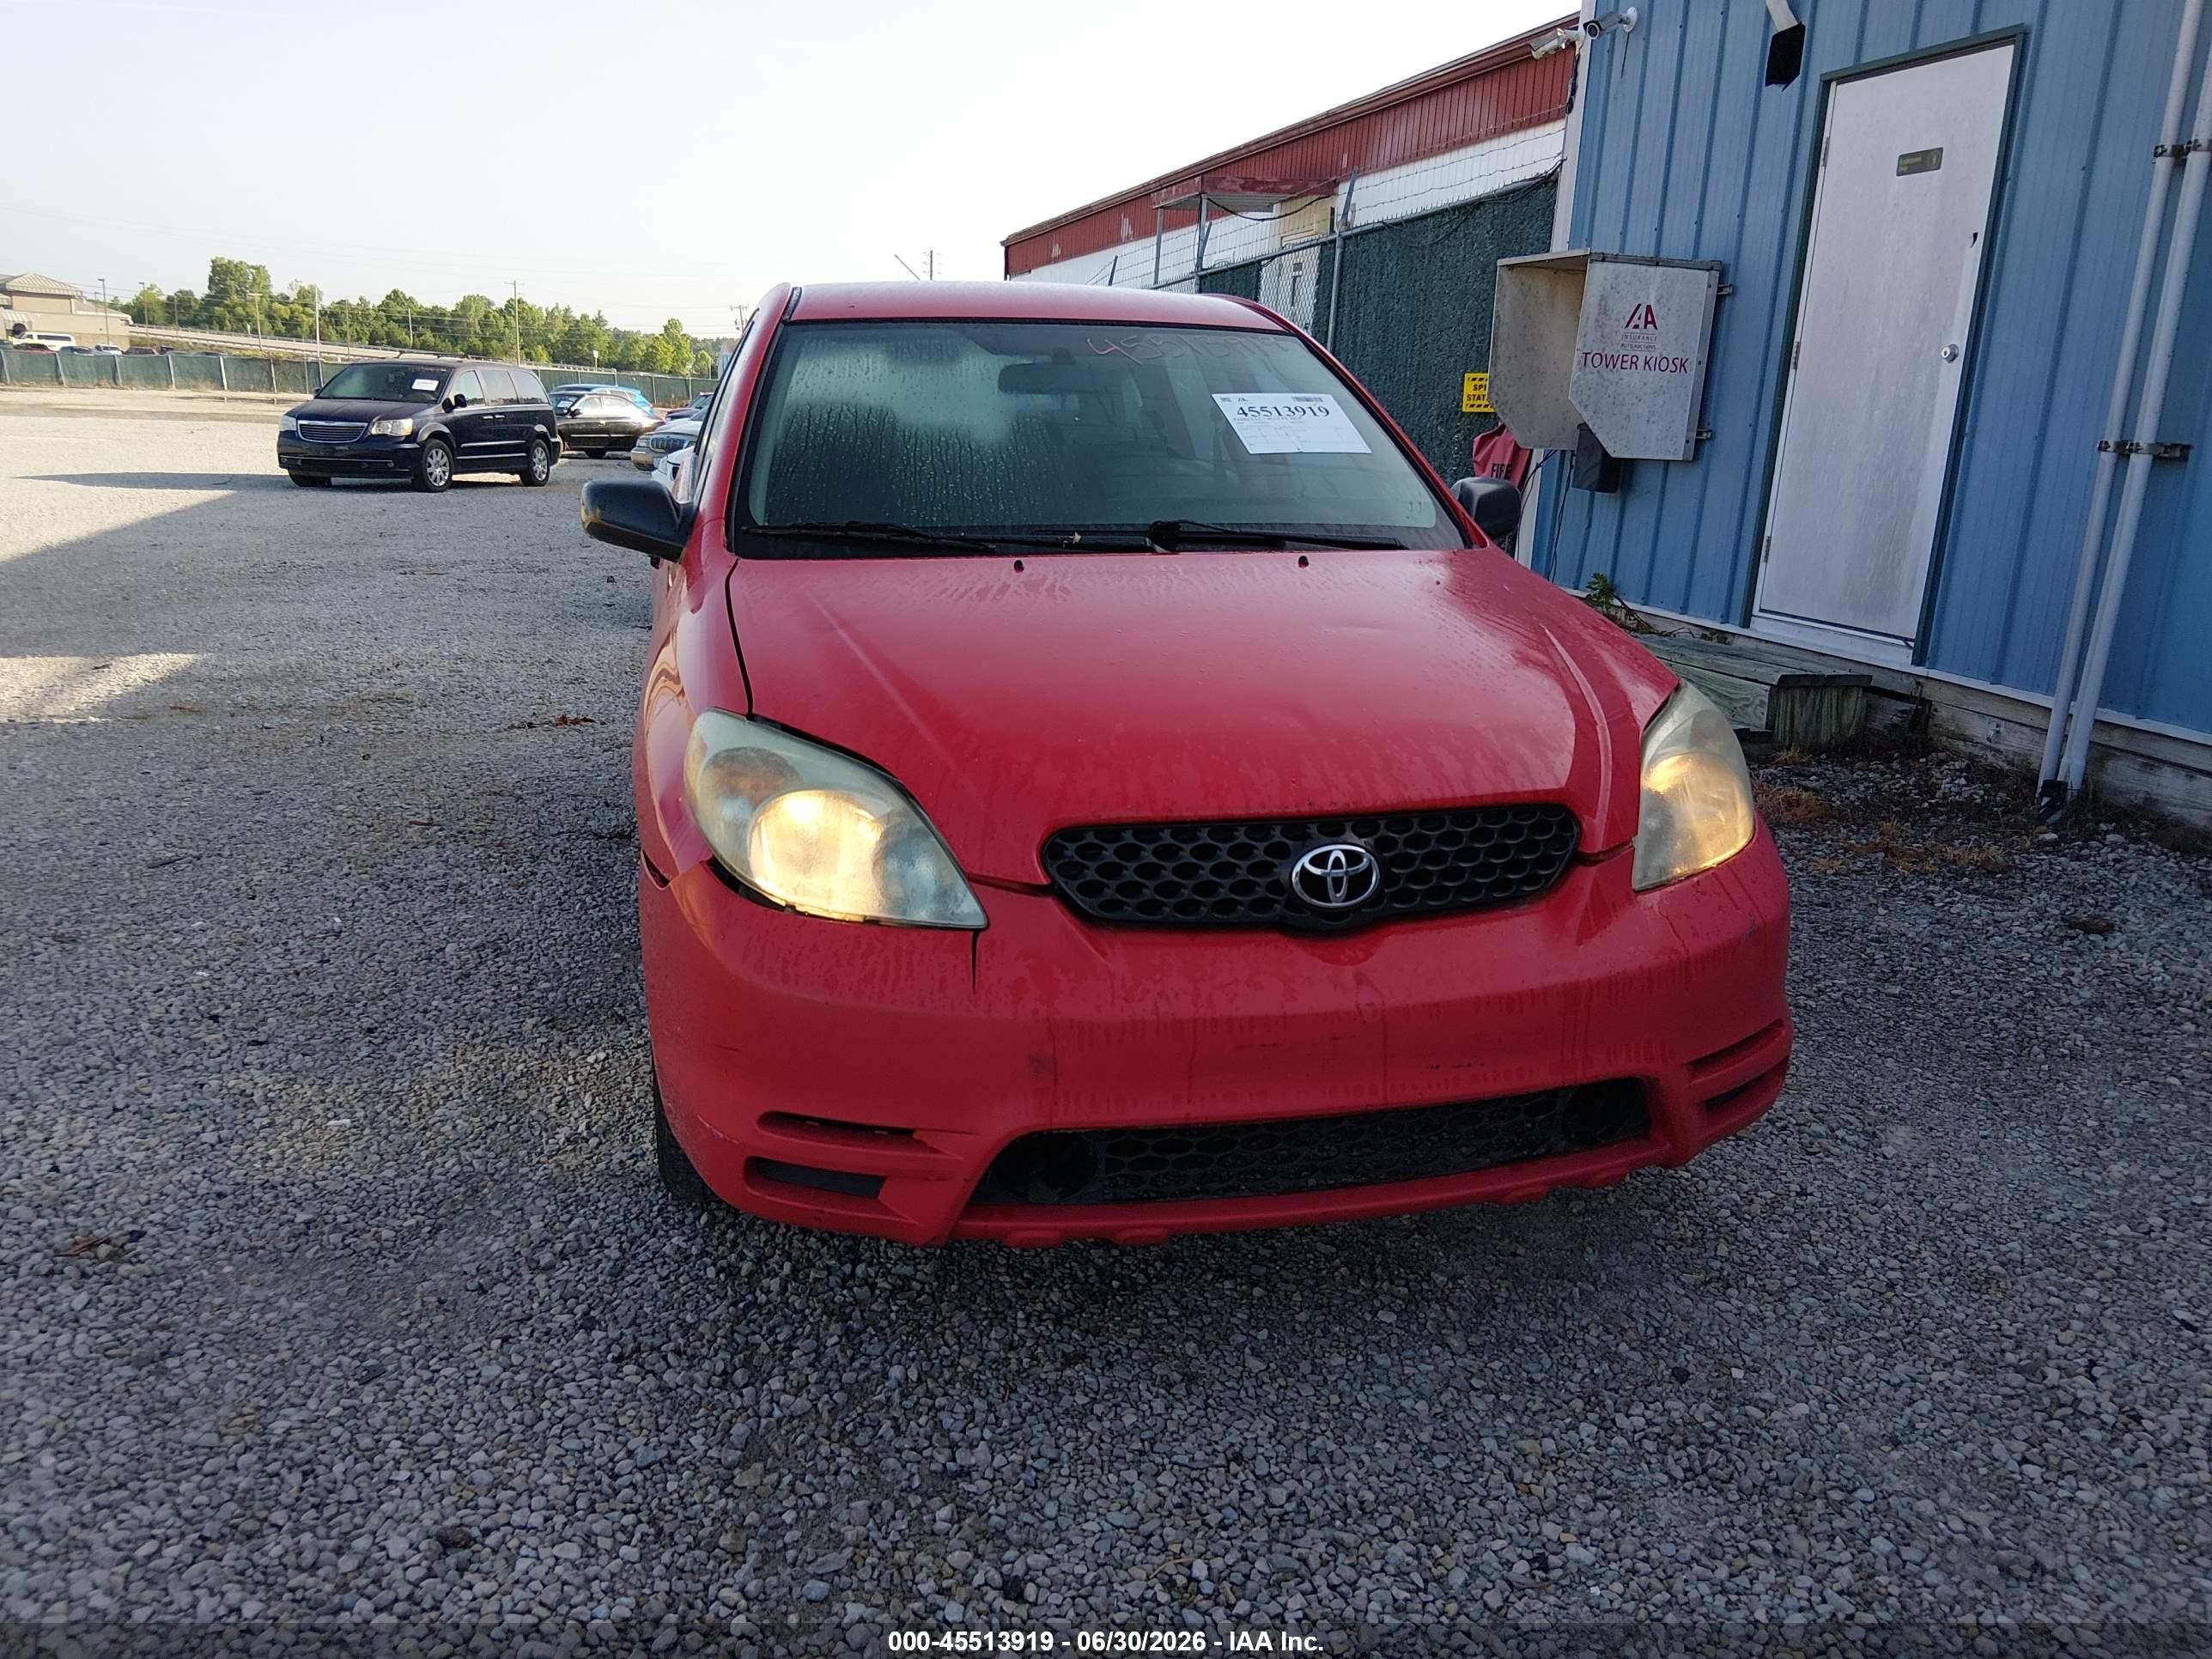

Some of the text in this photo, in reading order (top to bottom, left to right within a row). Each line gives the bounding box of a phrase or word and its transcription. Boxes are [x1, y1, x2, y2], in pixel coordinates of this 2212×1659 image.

[1582, 352, 1689, 374] TOWER KIOSK
[1237, 405, 1330, 417] 45513919
